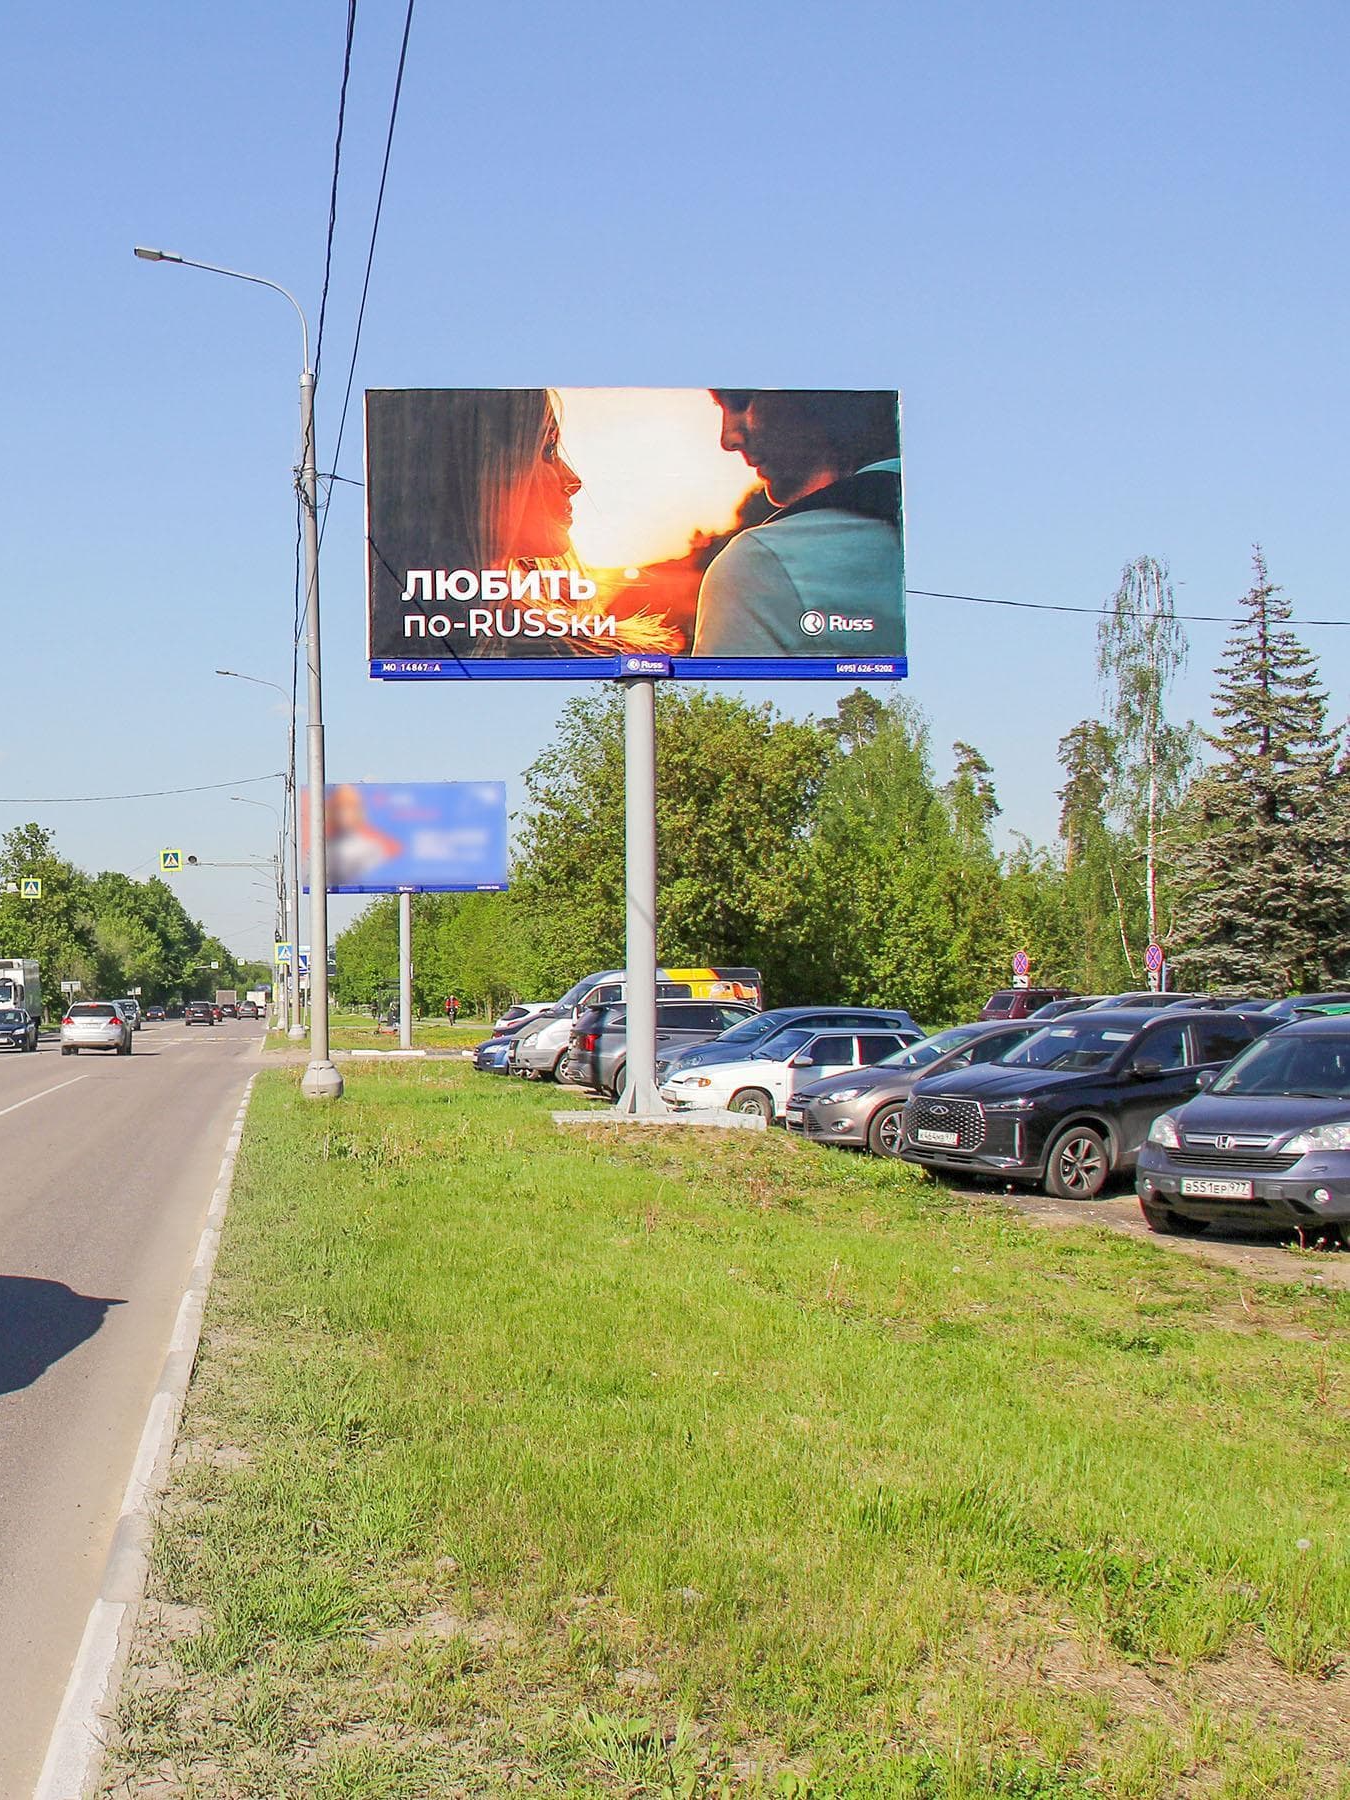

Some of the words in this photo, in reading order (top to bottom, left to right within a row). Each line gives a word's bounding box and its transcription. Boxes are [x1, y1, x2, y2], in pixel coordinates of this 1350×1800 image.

[401, 569, 597, 601] ЛЮБИТЬ
[404, 608, 617, 637] по-RUSSки
[829, 615, 873, 631] Russ
[640, 660, 664, 669] Russ
[836, 664, 856, 673] (495)
[857, 664, 893, 673] 626-5202
